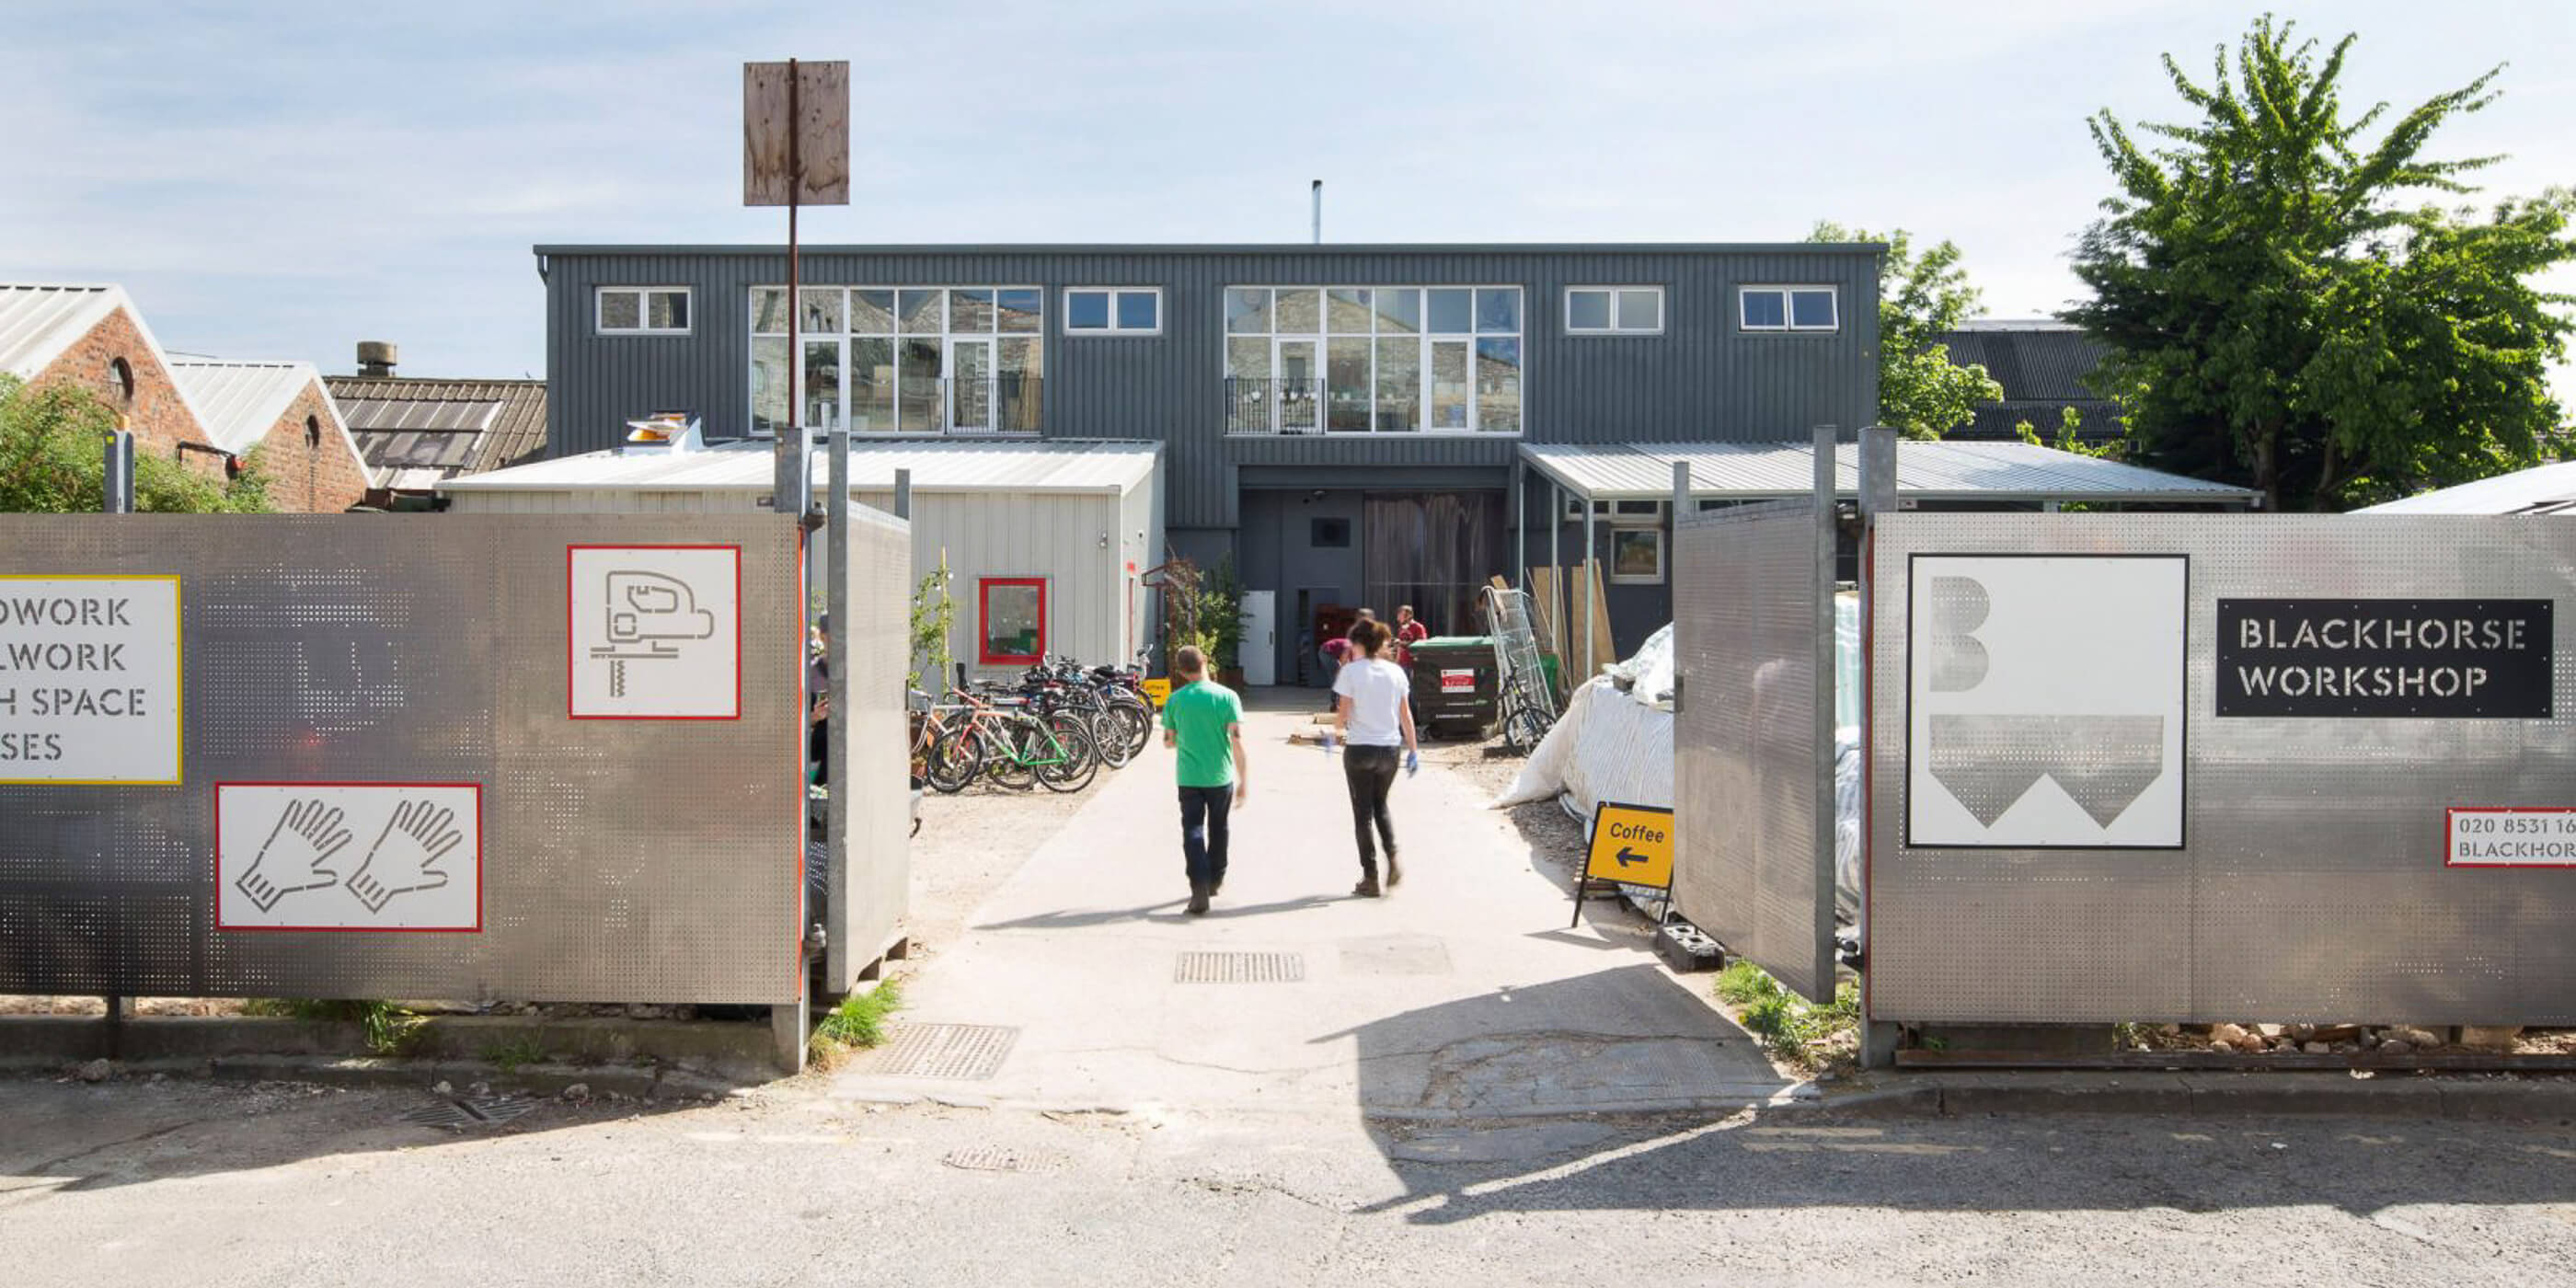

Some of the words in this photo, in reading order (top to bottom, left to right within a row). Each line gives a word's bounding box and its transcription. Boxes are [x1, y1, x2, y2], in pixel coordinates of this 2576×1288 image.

[2239, 618, 2525, 650] BLACKHORSE
[2237, 666, 2487, 696] WORKSHOP
[32, 688, 146, 716] SPACE
[1610, 822, 1664, 844] Coffee
[2459, 818, 2495, 834] 020
[2503, 818, 2547, 834] 8531
[2459, 842, 2576, 857] BLACKHOR
